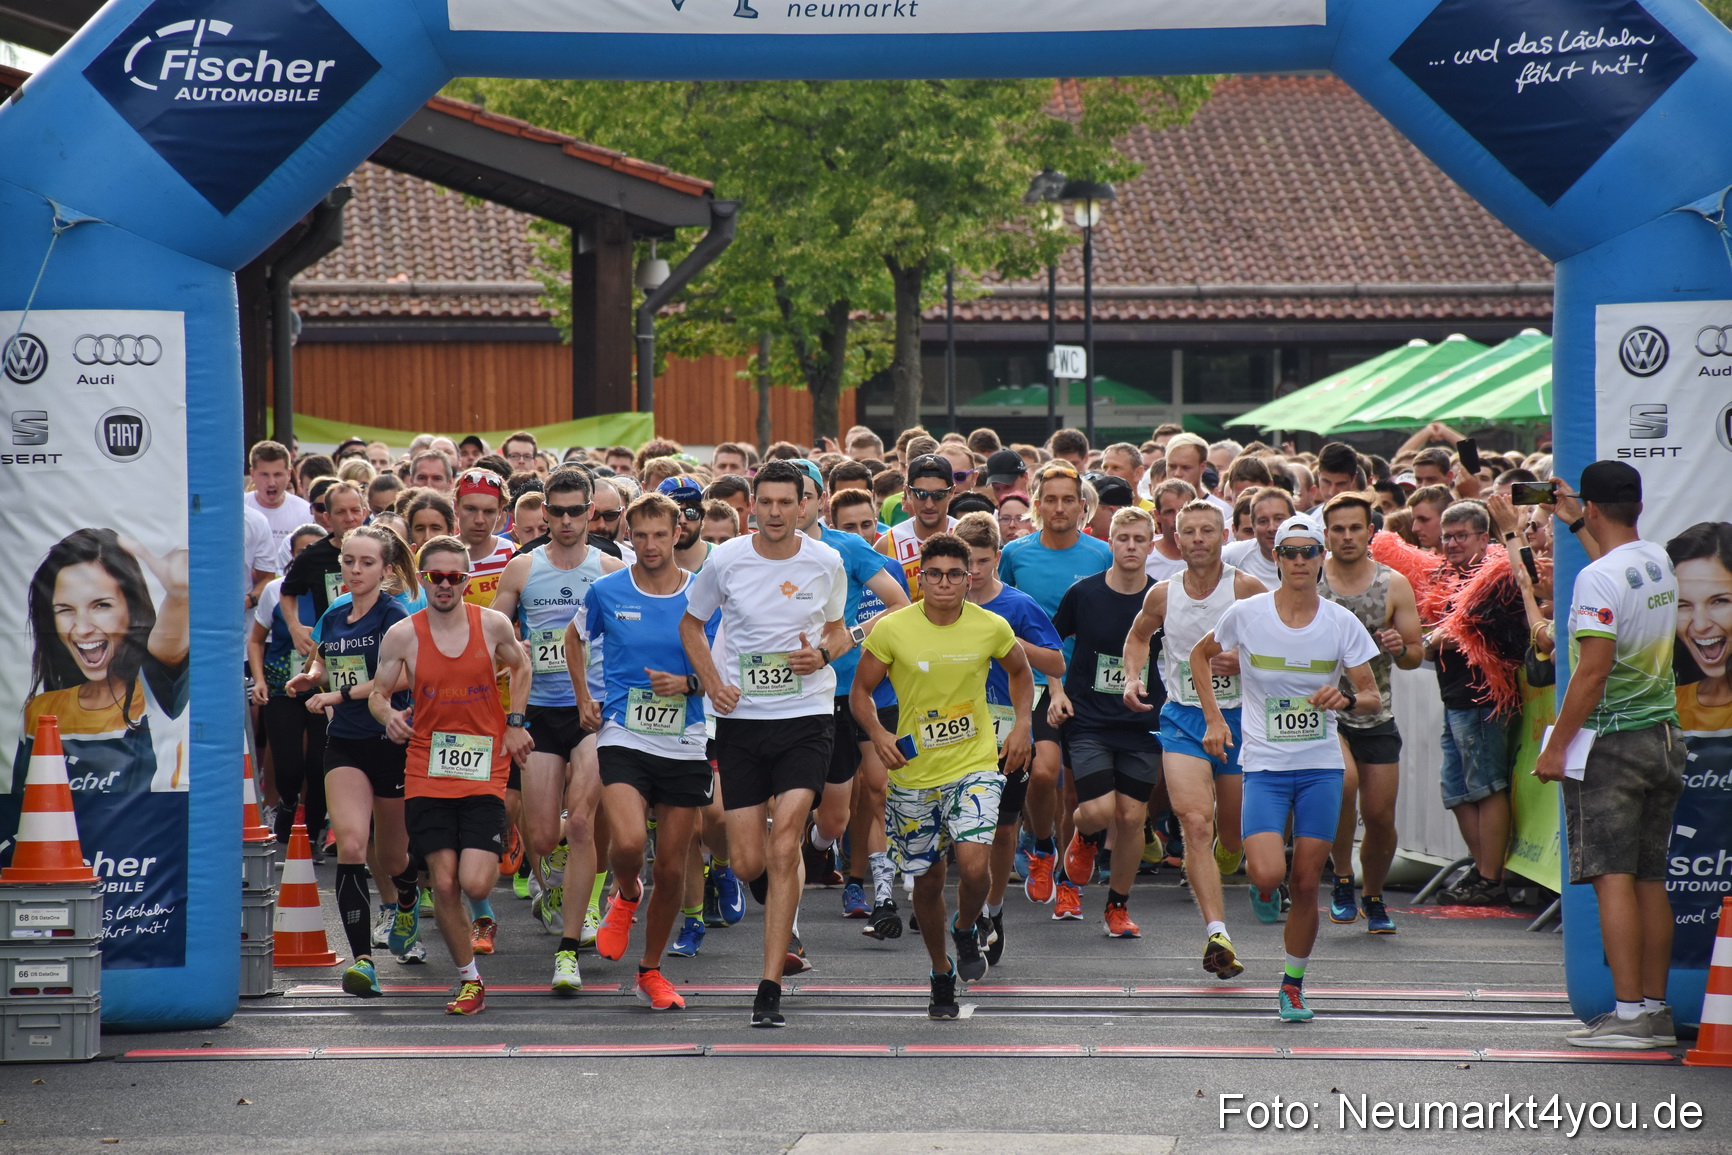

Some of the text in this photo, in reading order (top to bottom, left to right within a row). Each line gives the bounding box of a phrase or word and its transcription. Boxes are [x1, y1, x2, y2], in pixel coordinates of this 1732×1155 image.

[786, 0, 918, 18] neumarkt
[1453, 39, 1500, 65] und
[1507, 31, 1553, 56] das
[1558, 27, 1655, 54] Lächeln
[159, 49, 336, 83] Fischer
[1515, 53, 1649, 94] fährt mit!
[174, 87, 320, 102] AUTOMOBILE
[1058, 349, 1079, 374] WC
[76, 374, 115, 385] Audi
[108, 423, 140, 447] FIAT
[0, 453, 63, 465] SEAT
[1616, 447, 1682, 458] SEAT
[1647, 589, 1676, 610] CREW
[346, 635, 375, 650] POLES
[332, 671, 358, 688] 716
[747, 667, 794, 685] 1332
[634, 704, 680, 724] 1077
[1274, 712, 1320, 730] 1093
[925, 716, 970, 739] 1269
[438, 748, 484, 768] 1807
[19, 914, 30, 922] 68
[135, 919, 169, 934] mit!
[18, 970, 29, 978] 66
